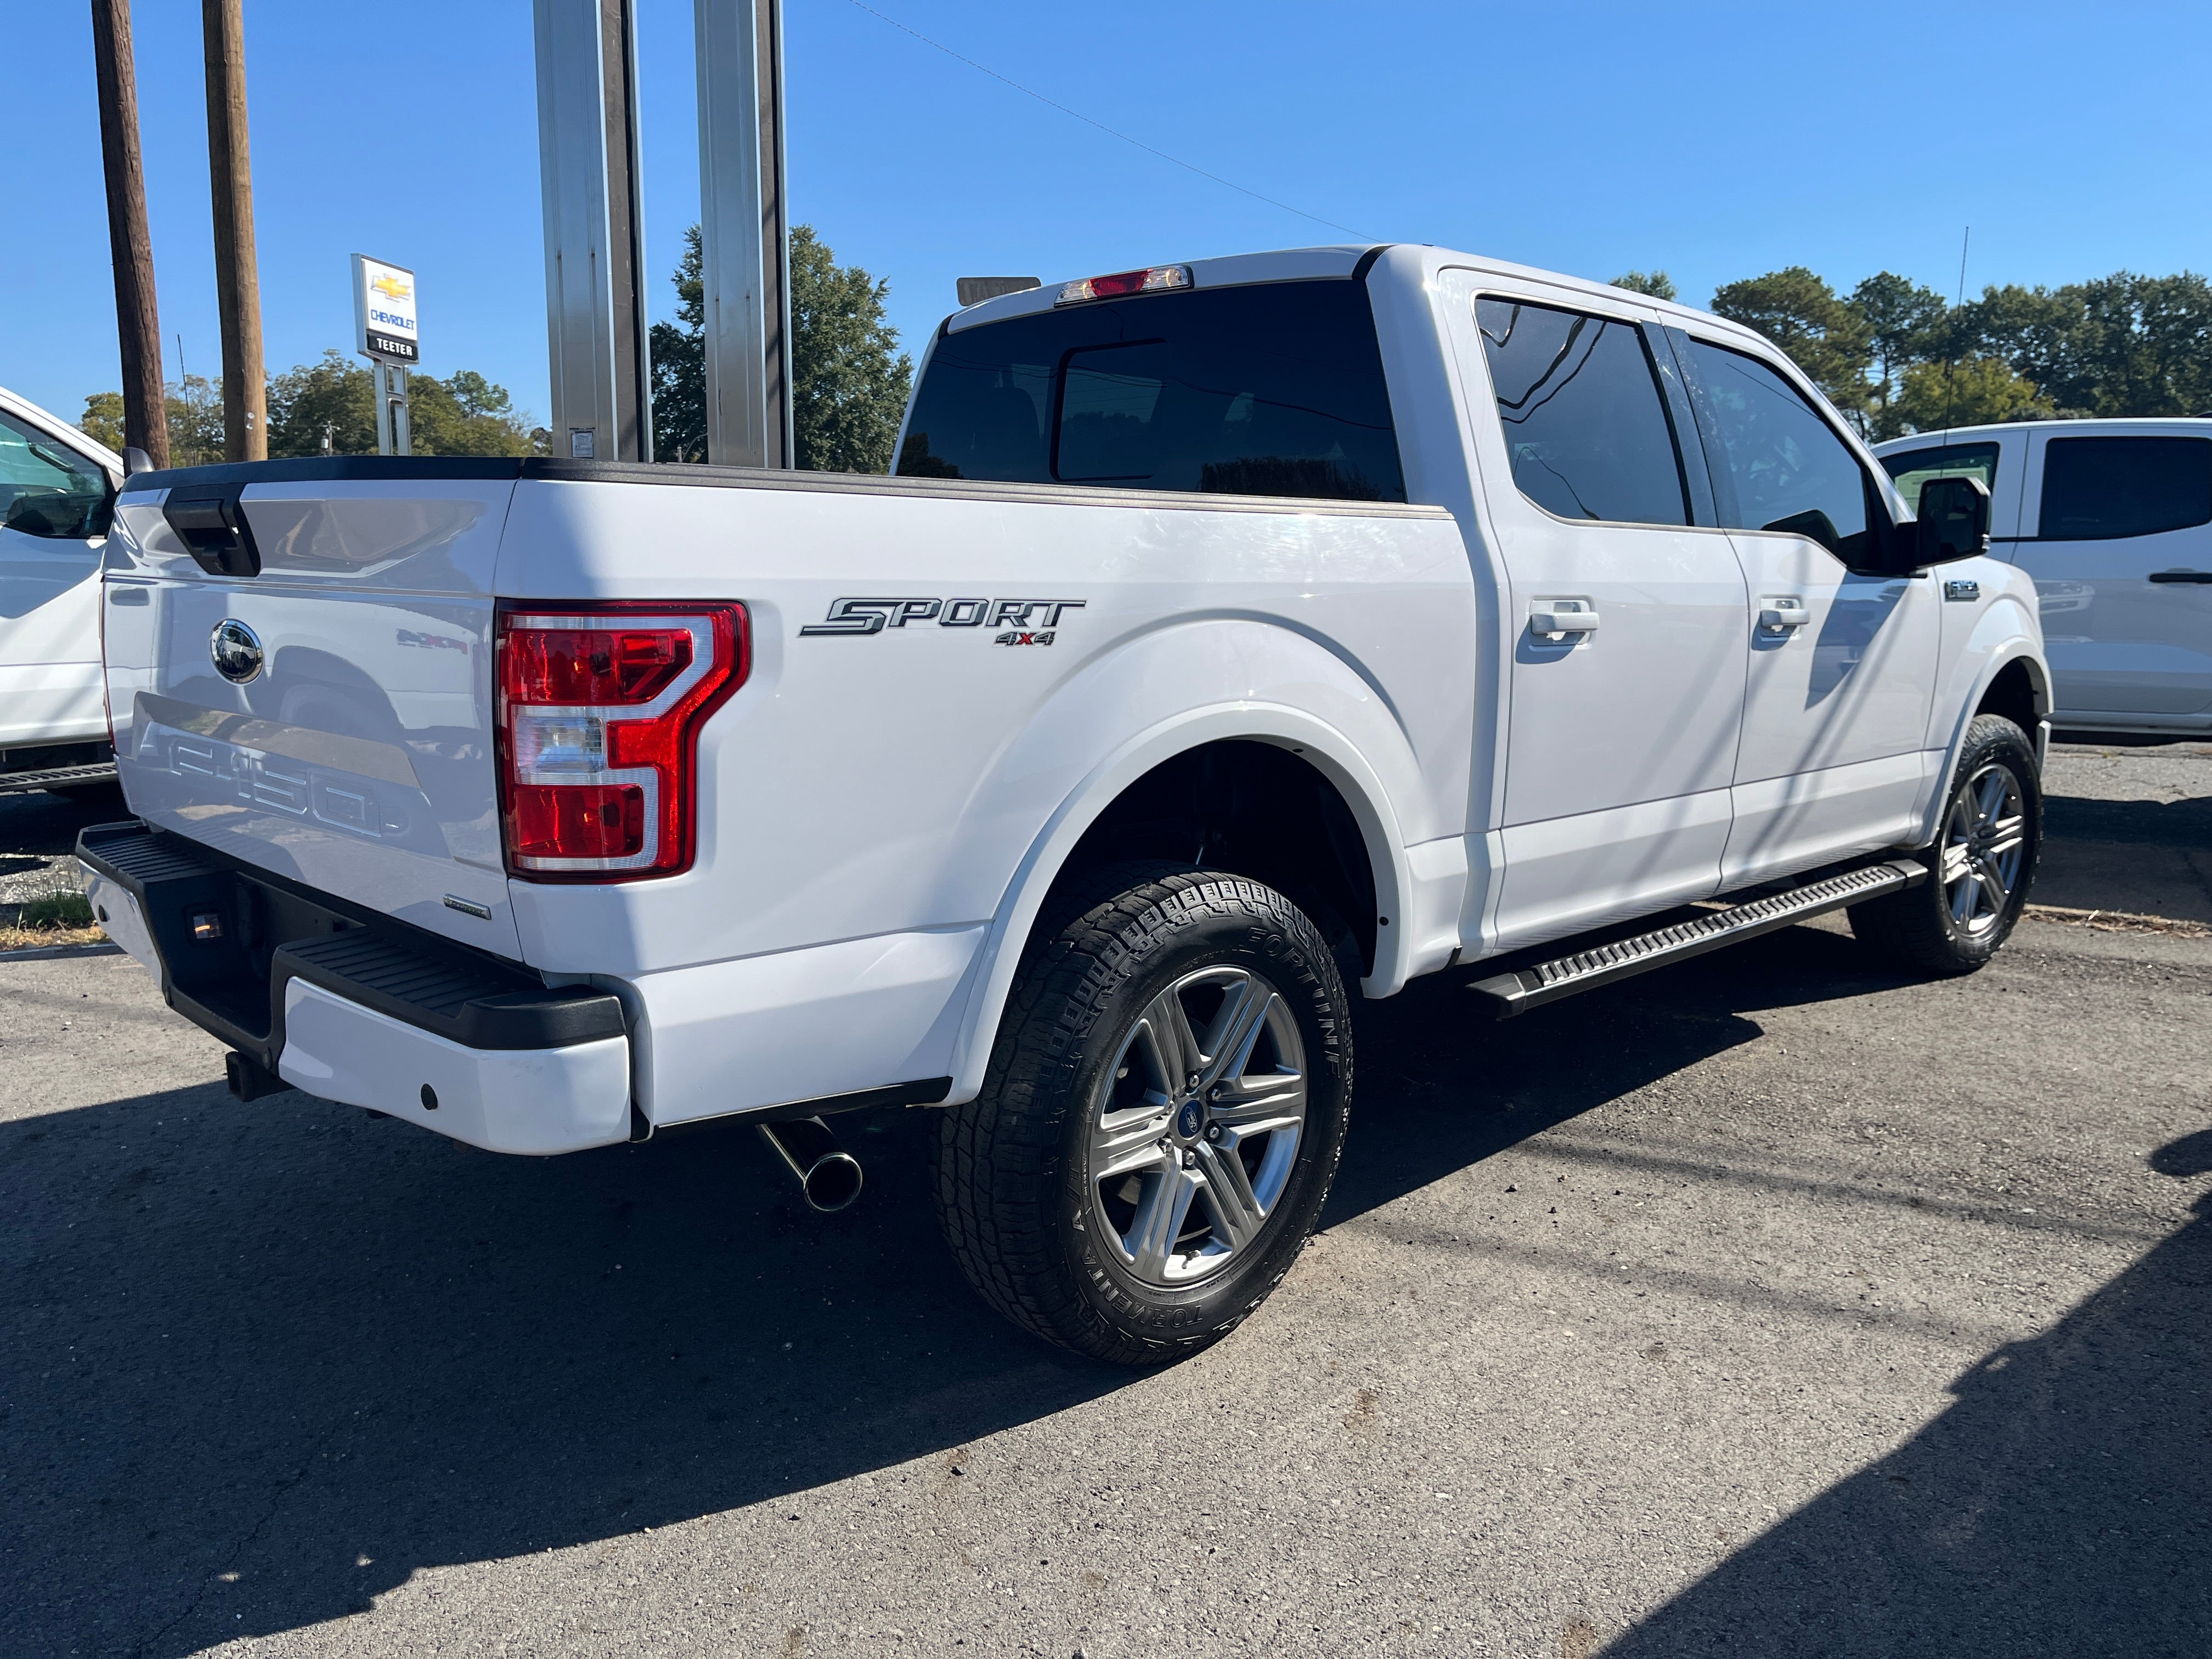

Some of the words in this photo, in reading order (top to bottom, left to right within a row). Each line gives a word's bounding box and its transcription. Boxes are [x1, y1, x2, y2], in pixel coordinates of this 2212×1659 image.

[371, 310, 414, 330] CHEVROLET
[376, 338, 413, 356] TEETER
[799, 597, 1087, 636] SPORT
[1187, 1110, 1197, 1128] Ford
